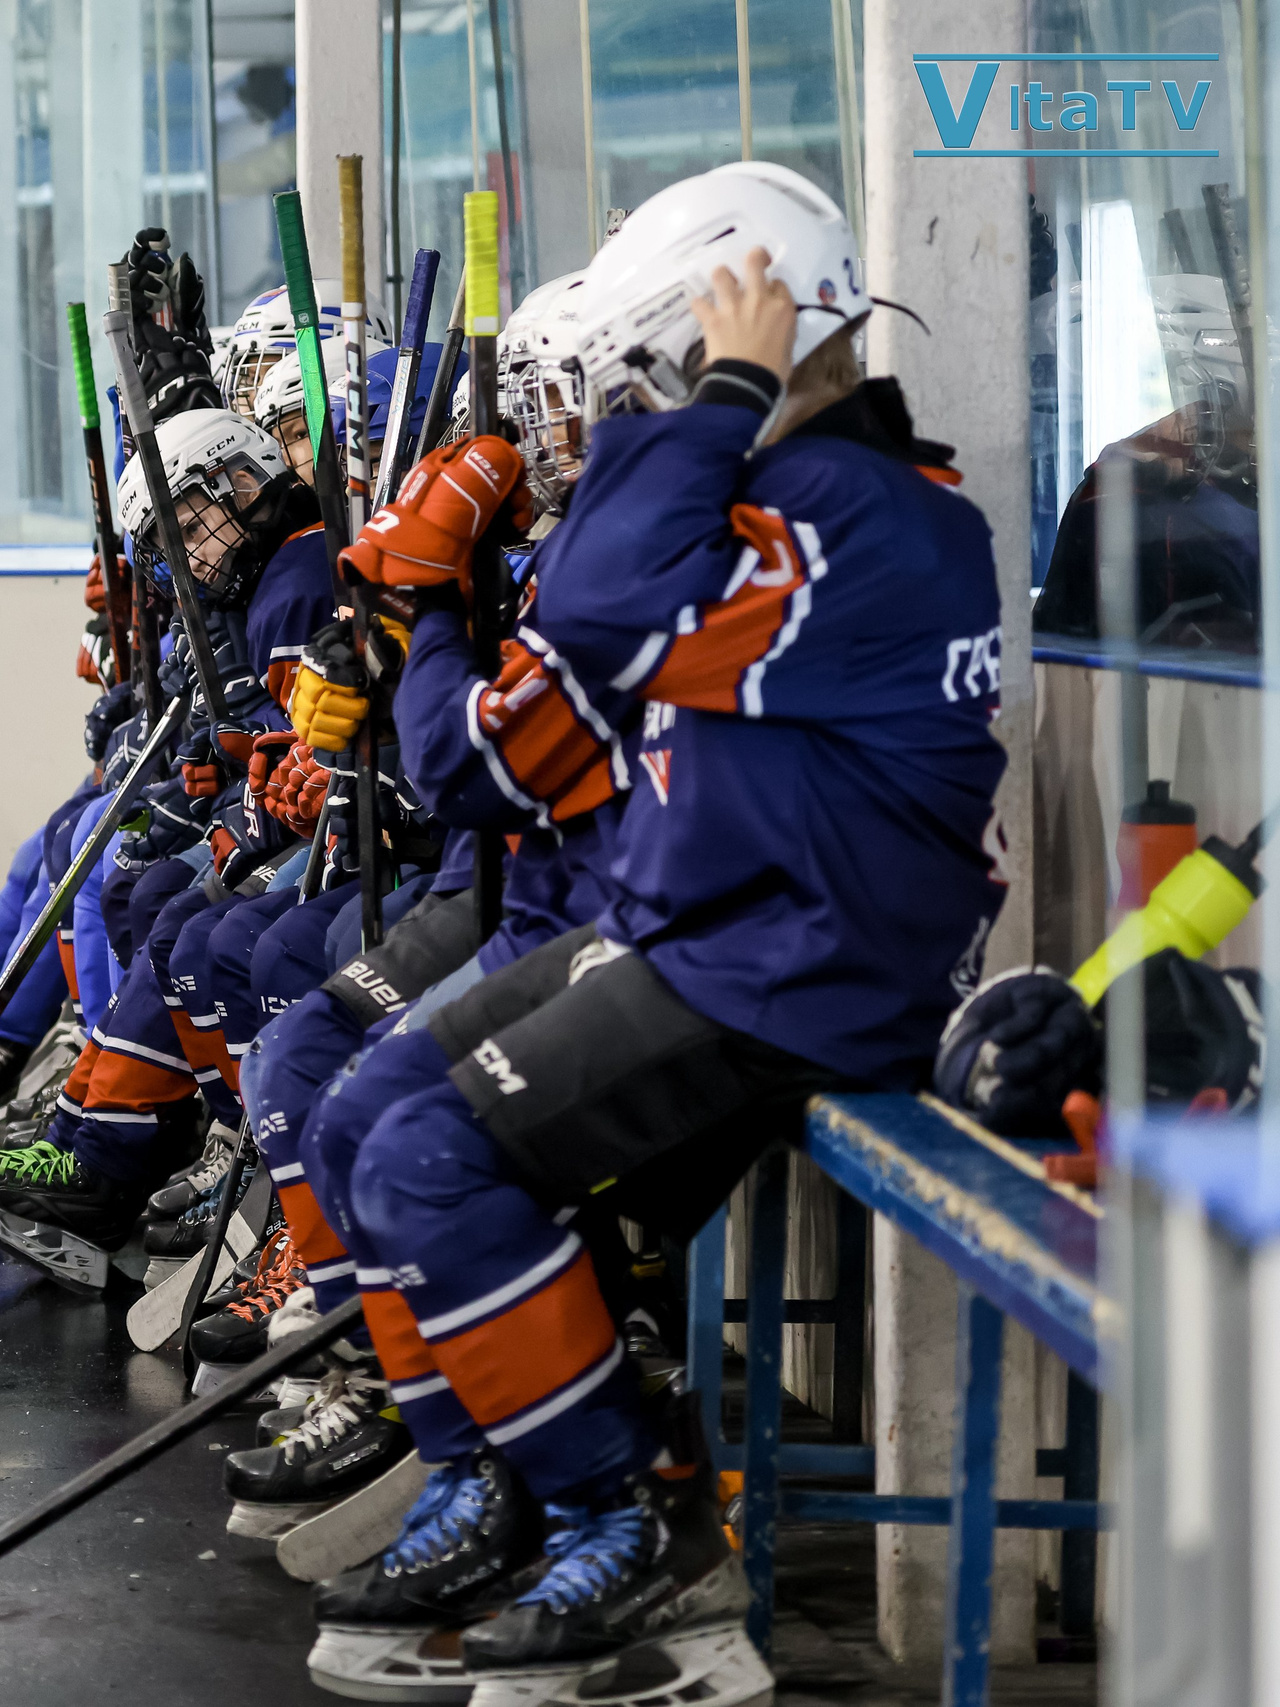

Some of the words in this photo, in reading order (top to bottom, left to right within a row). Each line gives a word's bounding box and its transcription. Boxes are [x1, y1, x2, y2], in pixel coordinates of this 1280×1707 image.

[346, 341, 365, 461] CCM
[206, 435, 236, 458] CCM
[121, 489, 138, 519] CCM
[472, 1037, 528, 1095] CM
